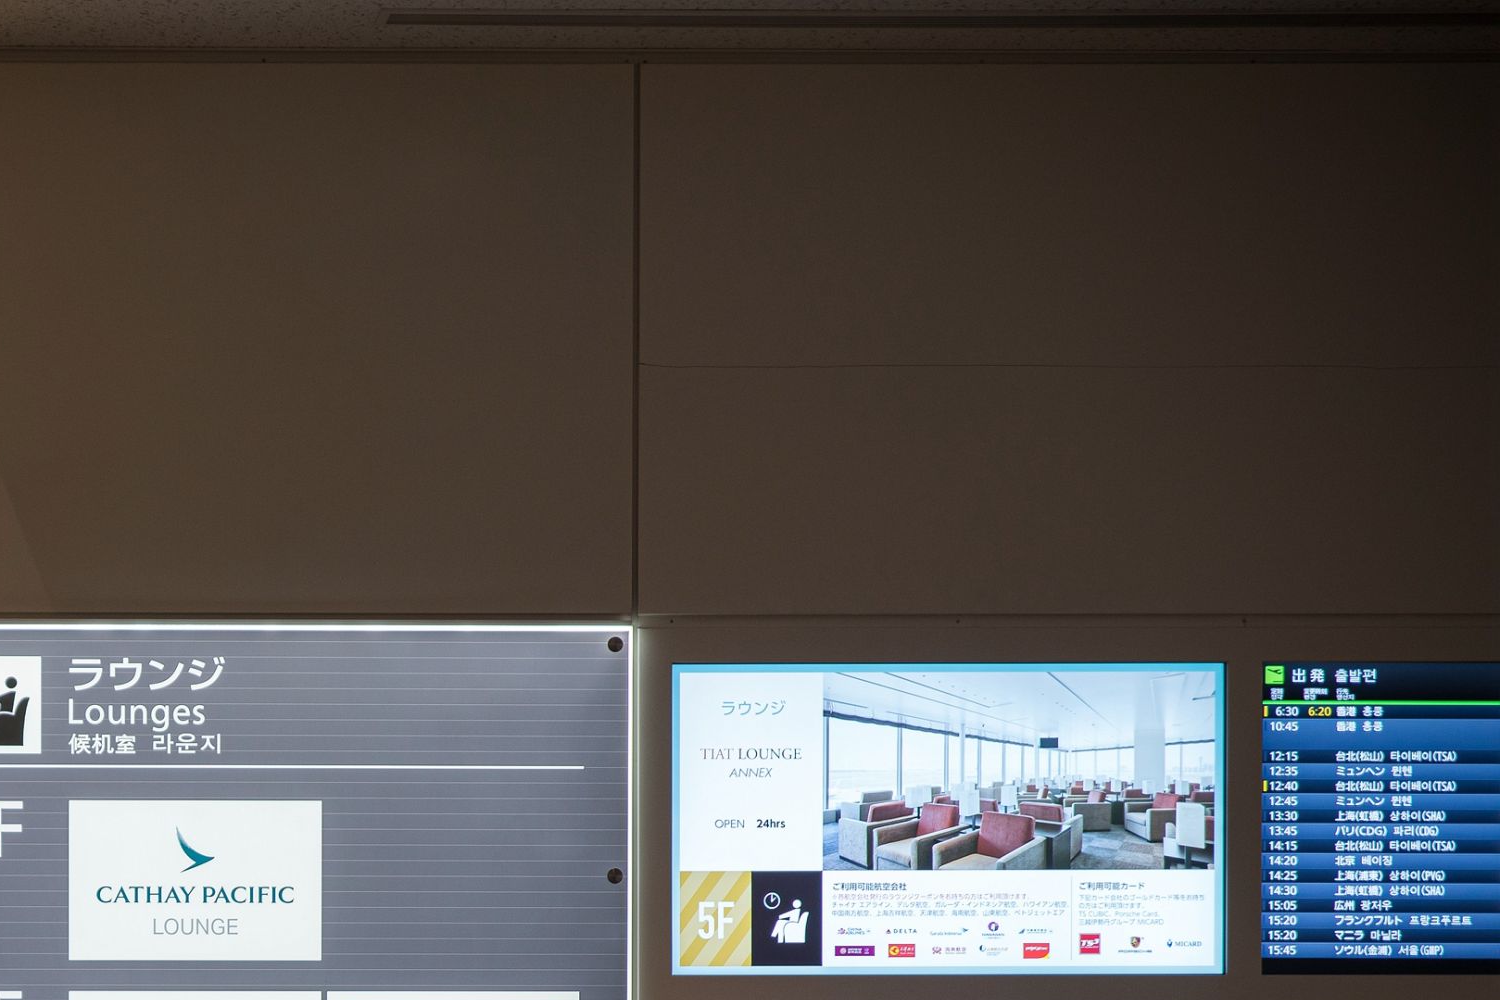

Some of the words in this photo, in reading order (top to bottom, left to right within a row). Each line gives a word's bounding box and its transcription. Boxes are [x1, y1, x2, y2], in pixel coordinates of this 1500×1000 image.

[69, 657, 225, 691] ラウンジ
[1292, 669, 1324, 683] 出発
[1335, 669, 1376, 683] 출발편
[722, 700, 786, 716] ラウンジ
[1276, 707, 1299, 716] 6:30
[1308, 707, 1332, 716] 6:20
[68, 698, 206, 730] Lounges
[1270, 722, 1299, 731] 10:45
[68, 733, 137, 755] 候机室
[152, 733, 222, 755] 라운지
[701, 748, 734, 760] TIAT
[738, 748, 802, 760] LOUNGE
[1269, 752, 1298, 761] 12:15
[1335, 752, 1384, 762] 台北(松山)
[1390, 751, 1457, 762] 타이베이(TSA)
[729, 768, 772, 778] ANNEX
[1269, 767, 1298, 776] 12:35
[1335, 767, 1384, 776] ミュンヘン
[1269, 782, 1298, 791] 12:40
[1269, 797, 1298, 806] 12:45
[1269, 812, 1298, 821] 13:30
[714, 819, 744, 828] OPEN
[756, 819, 786, 828] 24hrs
[1269, 826, 1298, 836] 13:45
[1335, 826, 1387, 837] パリ(CDG)
[1393, 826, 1438, 837] 파리(CDG)
[1269, 841, 1298, 850] 14:15
[1269, 856, 1297, 865] 14:20
[1335, 856, 1355, 866] 北京
[1361, 856, 1393, 866] 베이징
[1268, 871, 1297, 880] 14:25
[96, 885, 196, 904] CATHAY
[203, 885, 295, 904] PACIFIC
[1268, 886, 1297, 895] 14:30
[1268, 901, 1297, 910] 15:05
[697, 901, 735, 940] 5F
[1268, 916, 1297, 925] 15:20
[1335, 916, 1402, 925] フランクフルト
[1409, 916, 1472, 925] 프랑크푸르트
[152, 918, 238, 936] LOUNGE
[1268, 931, 1297, 940] 15:20
[1335, 931, 1364, 940] マニラ
[1371, 931, 1402, 941] 마닐라
[1268, 946, 1296, 955] 15:45
